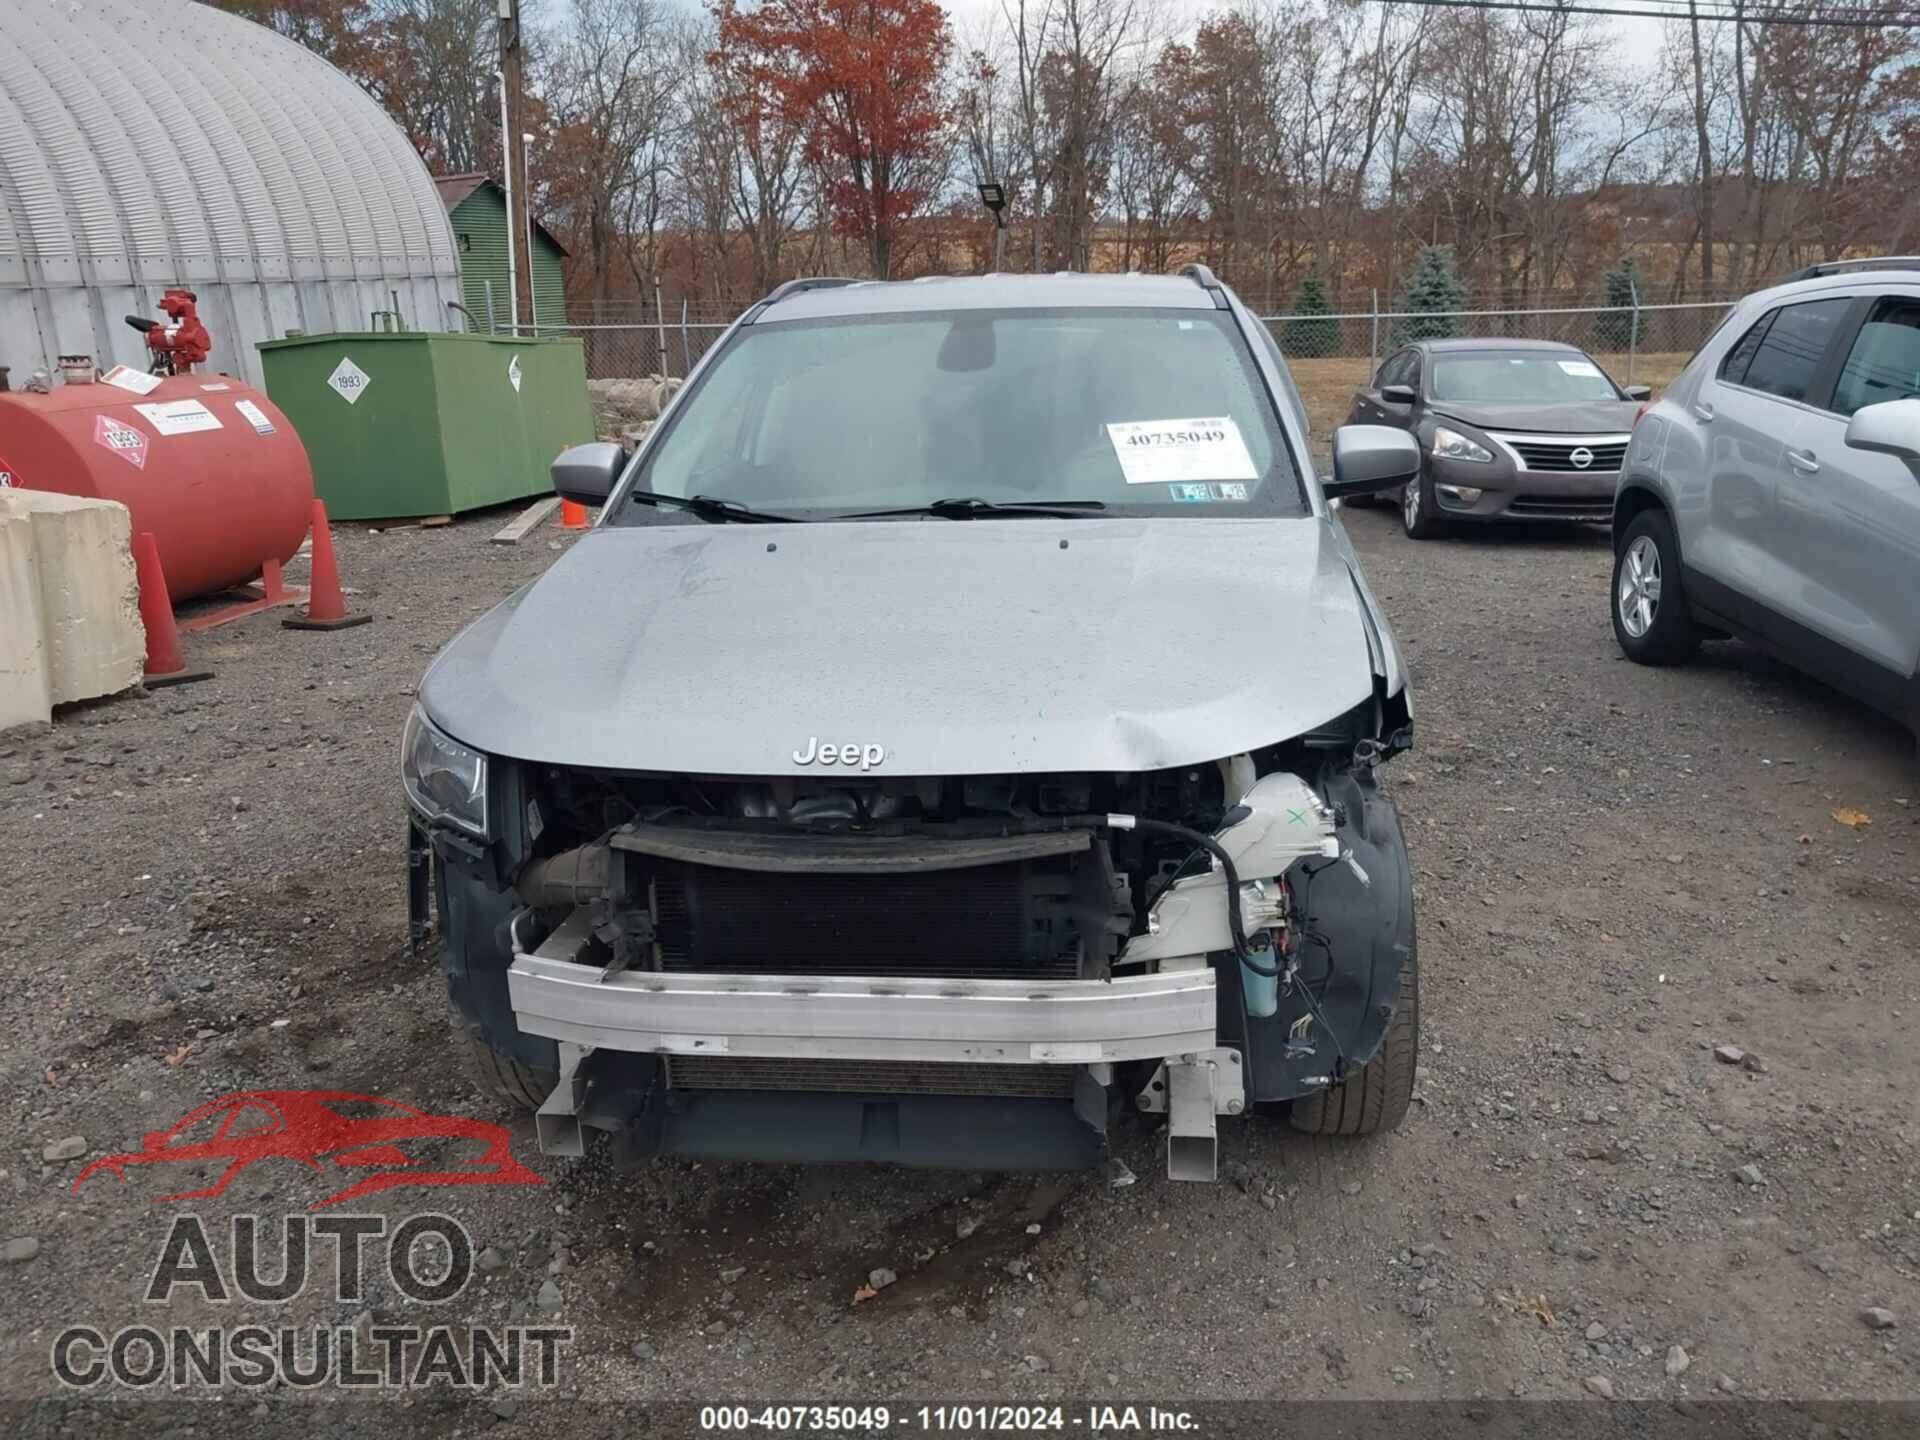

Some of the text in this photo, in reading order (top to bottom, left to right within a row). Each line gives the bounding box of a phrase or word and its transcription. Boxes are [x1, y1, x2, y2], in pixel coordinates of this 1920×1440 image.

[337, 375, 361, 388] 1993
[106, 431, 141, 447] 1993
[1127, 431, 1225, 446] 40735049
[792, 736, 885, 772] Jeep
